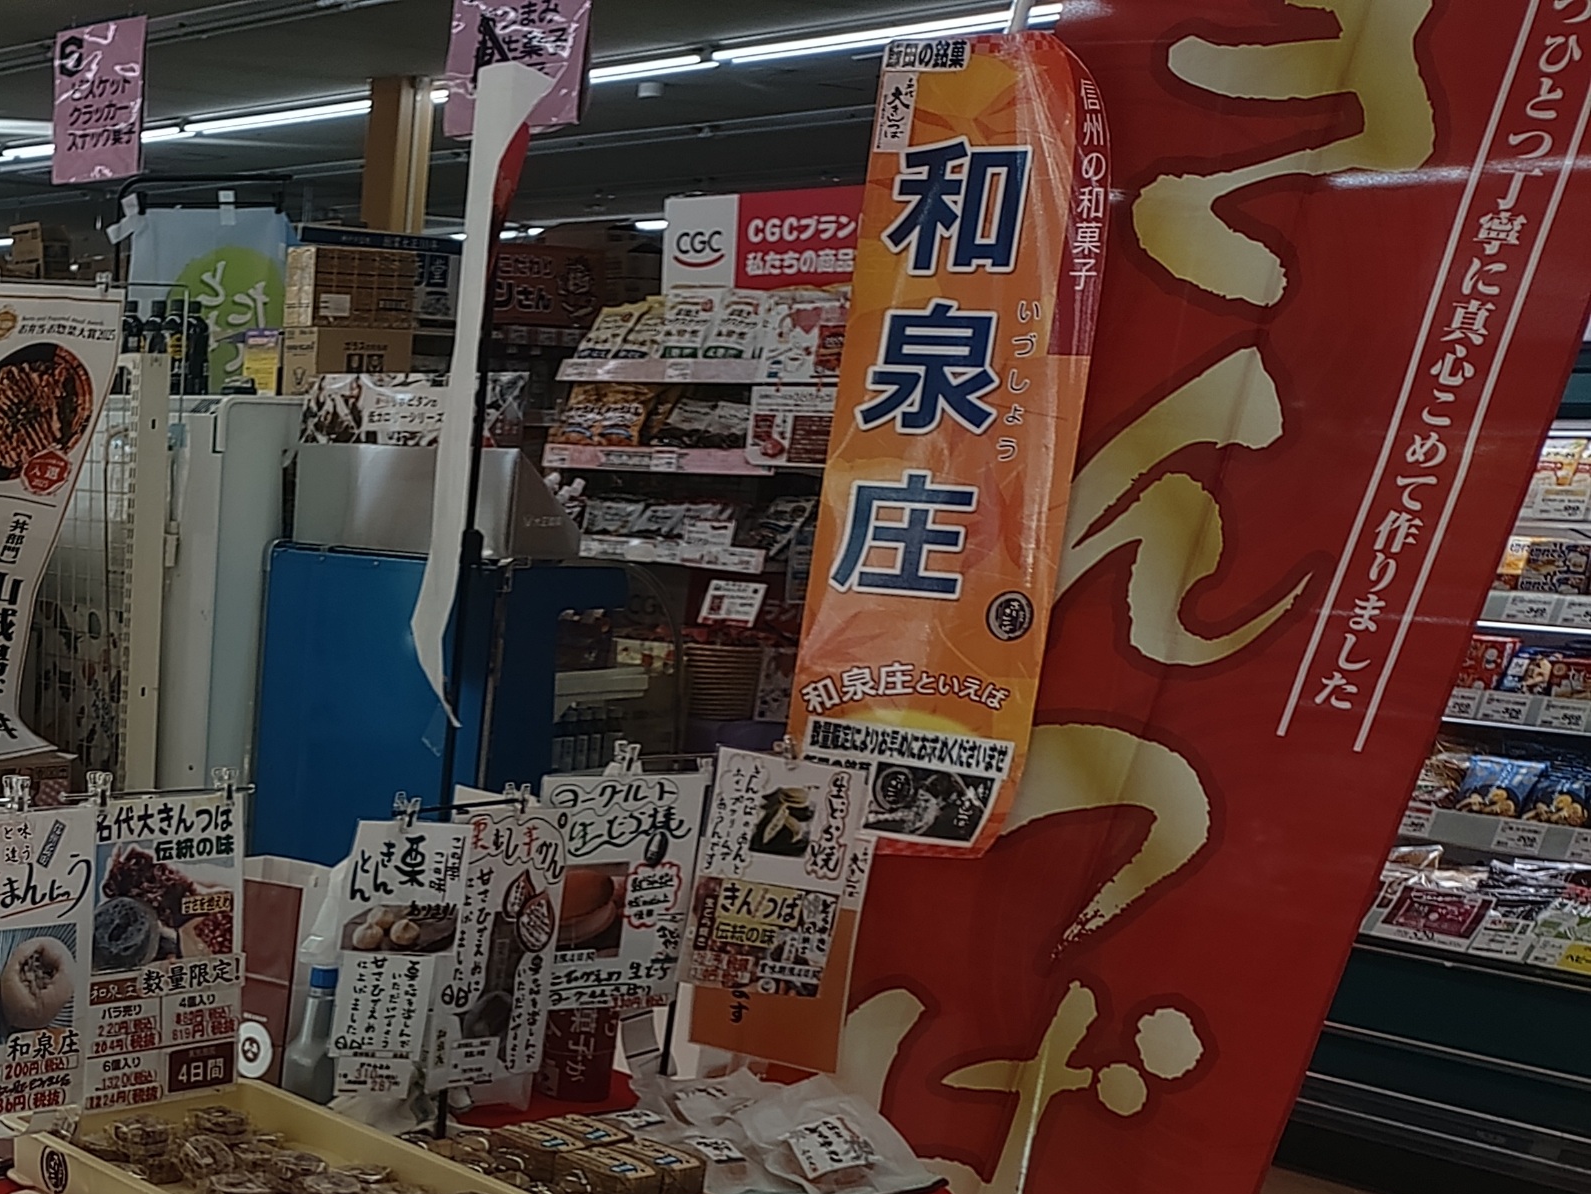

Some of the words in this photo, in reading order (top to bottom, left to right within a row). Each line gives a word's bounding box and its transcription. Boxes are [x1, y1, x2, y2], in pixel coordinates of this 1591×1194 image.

[885, 39, 967, 68] 飯田の銘菓
[70, 102, 130, 127] クラッカー
[67, 122, 136, 151] スナック菓子
[1069, 79, 1108, 292] 信州の和菓子
[674, 229, 724, 254] CGC
[747, 214, 860, 244] CGCブラン
[745, 252, 857, 276] 私たちの商品
[830, 138, 1033, 598] 和泉庄
[996, 300, 1041, 462] いづしょう
[801, 661, 1011, 714] 和泉庄といえば
[555, 780, 678, 809] ヨーグルト
[810, 775, 848, 874] 生どら焼
[5, 846, 33, 863] 違う
[154, 834, 235, 862] 伝統の味
[394, 834, 427, 887] 栗
[471, 818, 561, 881] 栗むし羊かん
[721, 882, 804, 923] きんつば
[715, 921, 777, 946] 伝統の味
[142, 957, 242, 995] 数量限定!
[101, 1004, 142, 1020] バラ売り
[178, 994, 216, 1008] 4個入り
[7, 1029, 81, 1061] 和泉庄
[4, 1055, 71, 1081] 200円(税込)
[102, 1056, 141, 1073] 6個入り
[178, 1057, 225, 1084] 4日間
